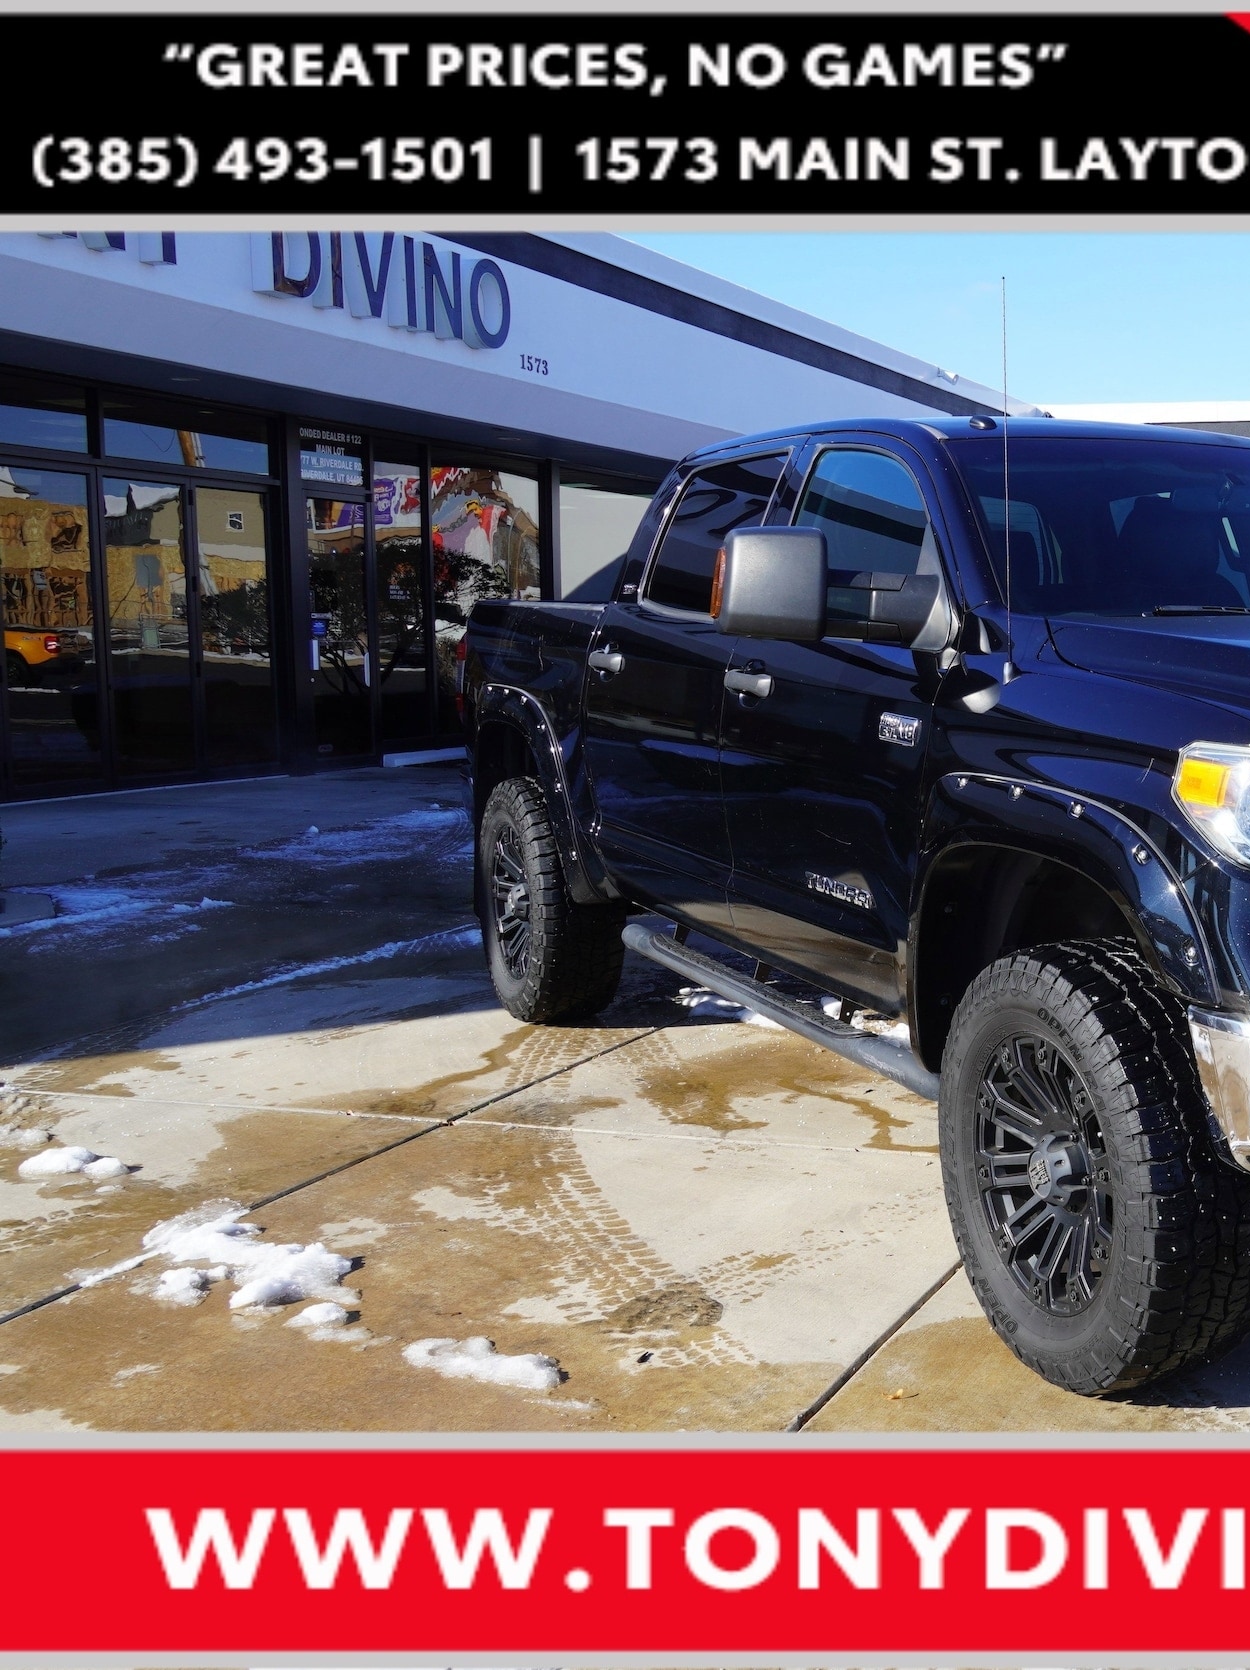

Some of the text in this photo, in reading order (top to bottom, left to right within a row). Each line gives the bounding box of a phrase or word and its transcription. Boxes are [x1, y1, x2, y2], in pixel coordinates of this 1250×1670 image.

[256, 231, 511, 349] DIVINO
[519, 353, 549, 376] 1573
[299, 427, 321, 439] ONDED
[322, 430, 345, 442] DEALER
[351, 435, 362, 444] 122
[316, 444, 345, 456] MAIN LOT
[1037, 1007, 1084, 1062] OPEN
